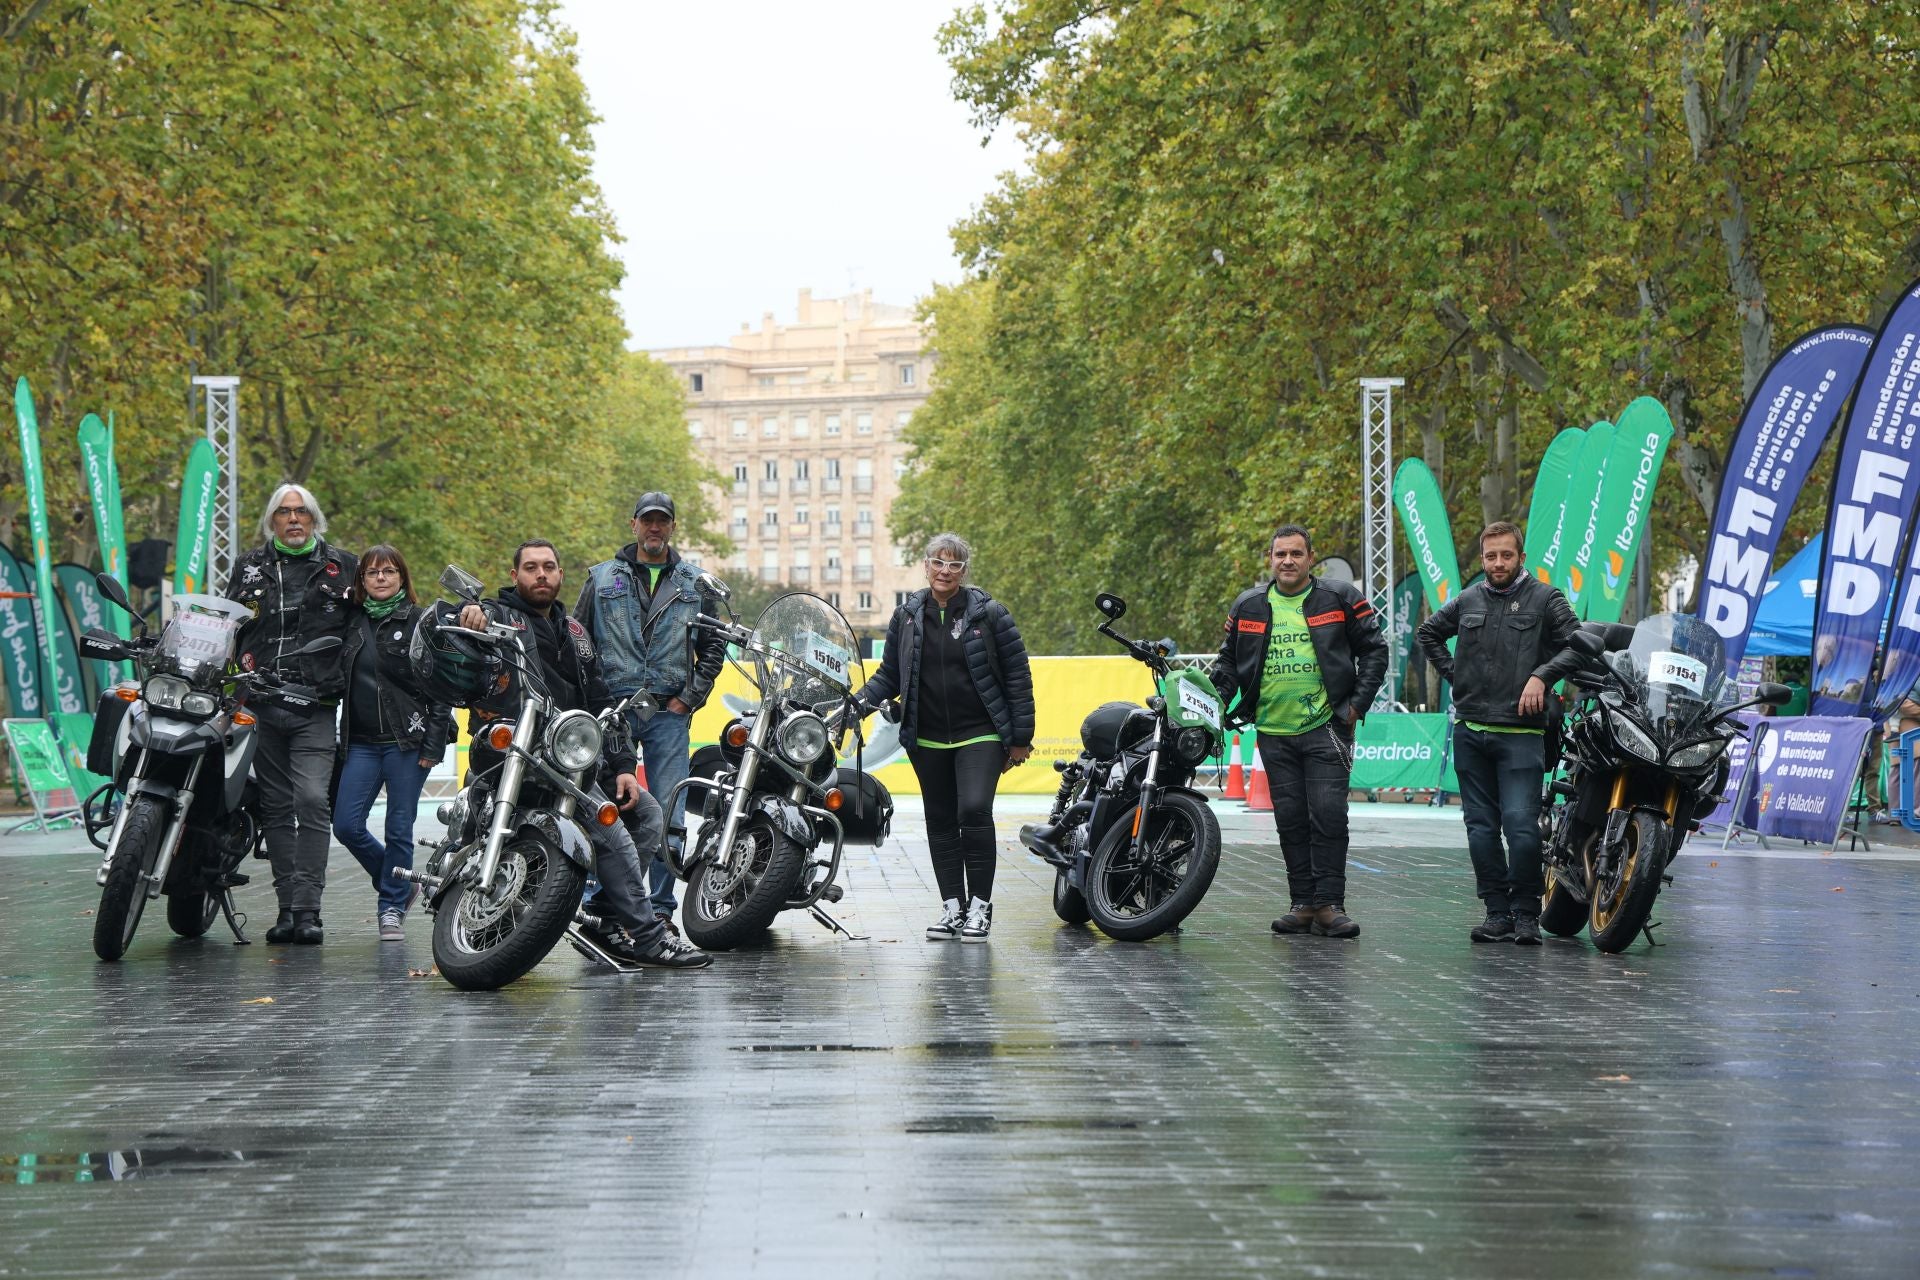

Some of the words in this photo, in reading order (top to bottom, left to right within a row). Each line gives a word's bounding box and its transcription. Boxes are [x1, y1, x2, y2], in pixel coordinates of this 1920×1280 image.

[1866, 332, 1916, 441] Fundación
[1882, 341, 1920, 446] Municip
[1743, 384, 1793, 480] Fundación
[1756, 390, 1807, 486] Municipal
[1770, 468, 1787, 492] de
[1781, 368, 1837, 464] Deportes
[1900, 422, 1917, 450] de
[1615, 432, 1660, 551] Iberdrola
[1270, 632, 1312, 645] marc
[813, 649, 841, 674] 15168
[283, 695, 311, 706] WRS
[1783, 729, 1832, 743] Fundación
[1780, 746, 1827, 761] Municipal
[1776, 763, 1789, 776] de
[1789, 764, 1835, 780] Deportes
[1775, 792, 1786, 810] de
[1787, 792, 1826, 814] Valladolid
